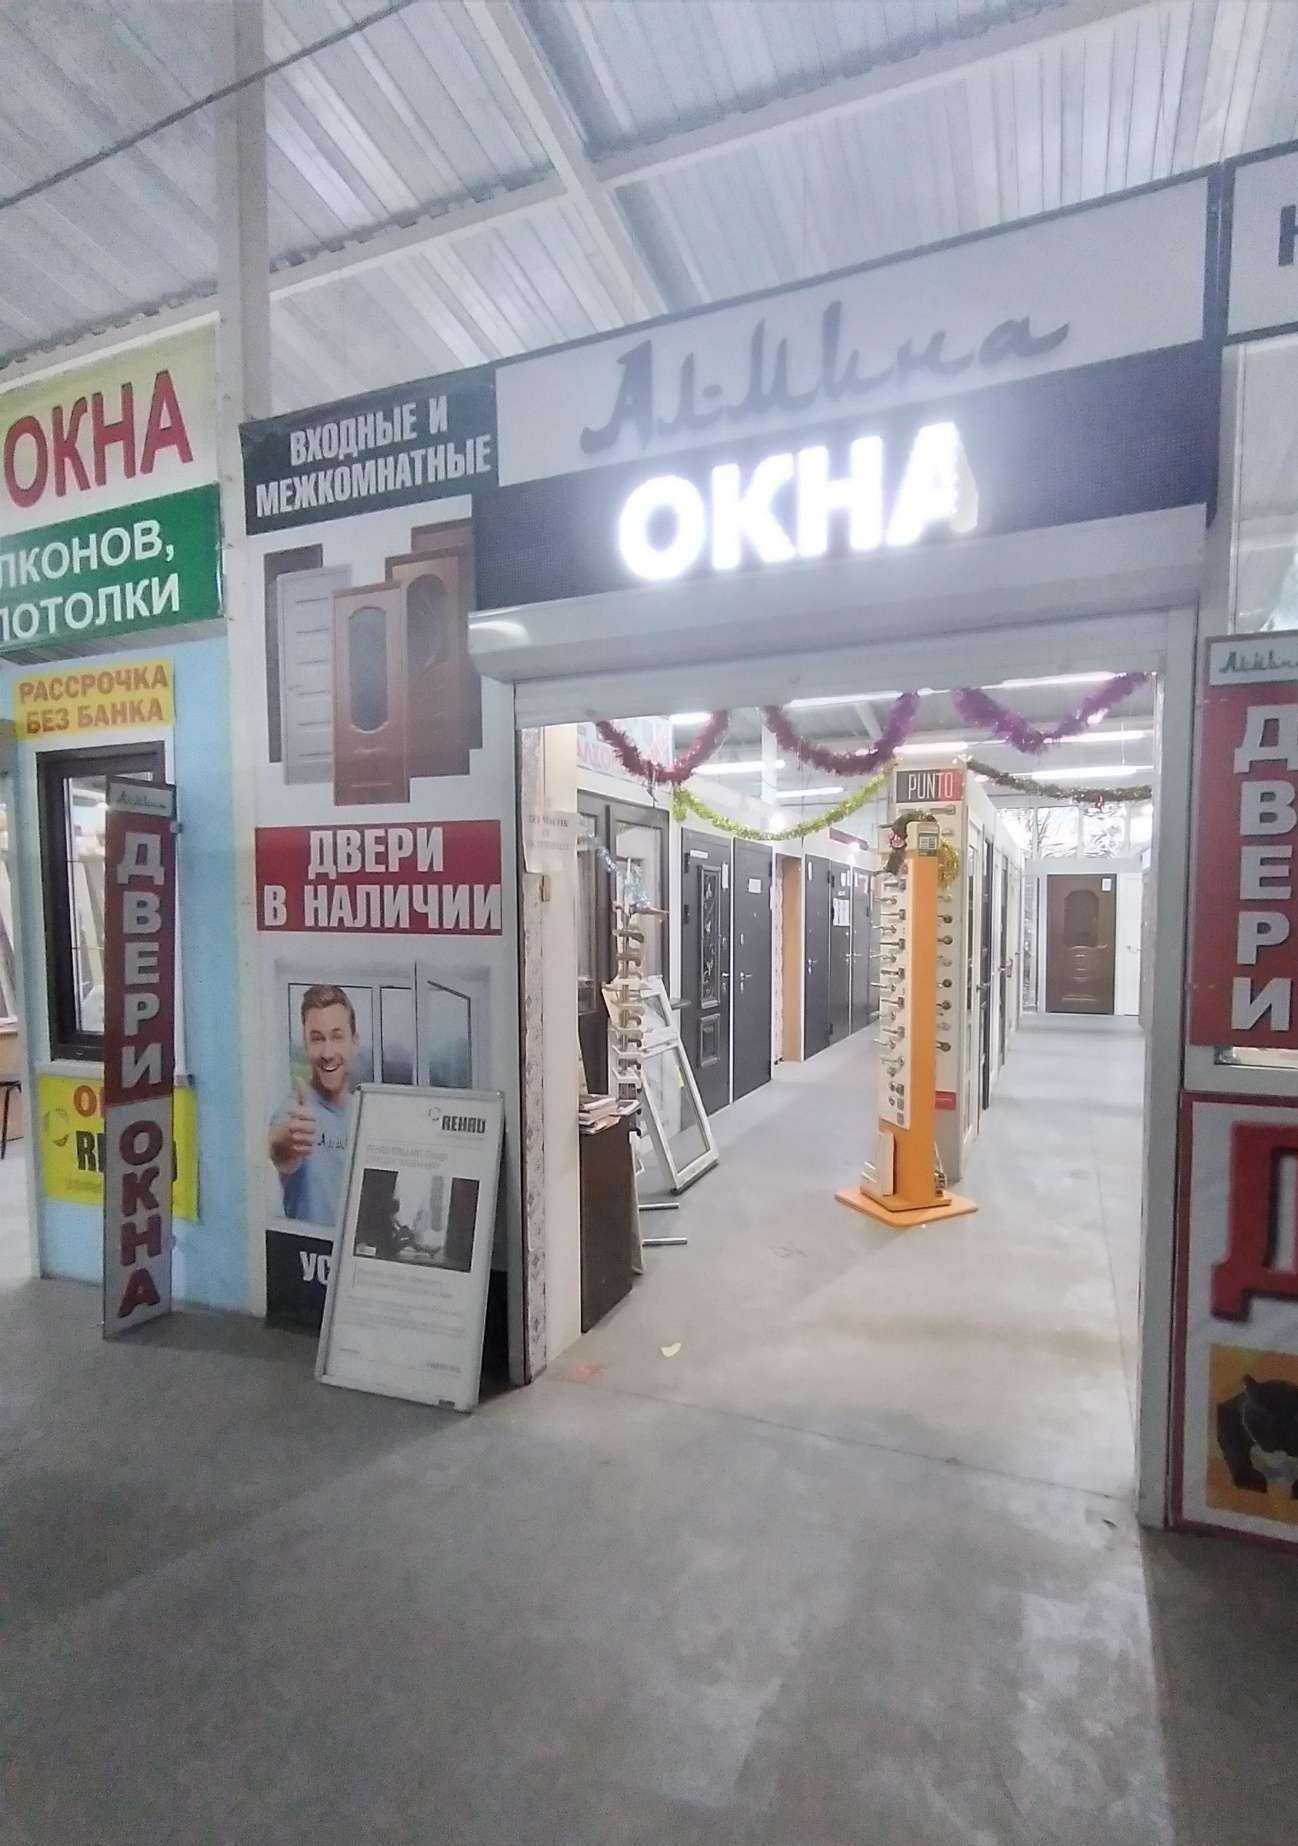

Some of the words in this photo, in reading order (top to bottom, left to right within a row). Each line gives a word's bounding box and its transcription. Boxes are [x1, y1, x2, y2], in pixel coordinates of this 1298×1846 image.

[4, 370, 193, 508] ОКНА
[290, 402, 418, 466] ВХОДНЫЕ
[429, 396, 448, 434] И
[255, 434, 492, 518] МЕЖКОМНАТНЫЕ
[617, 420, 980, 583] ОКНА
[19, 664, 168, 703] РАССРОЧКА
[26, 708, 70, 735] БЕЗ
[77, 698, 164, 727] БАНКА
[908, 771, 954, 800] PUNTO
[308, 826, 444, 880] ДВЕРИ
[1231, 703, 1298, 1032] ДВЕРИ
[263, 885, 287, 926] В
[303, 884, 502, 930] НАЛИЧИИ
[116, 831, 165, 1089] ДВЕРИ
[441, 1115, 486, 1134] REHAU
[117, 1120, 164, 1319] ОКНА
